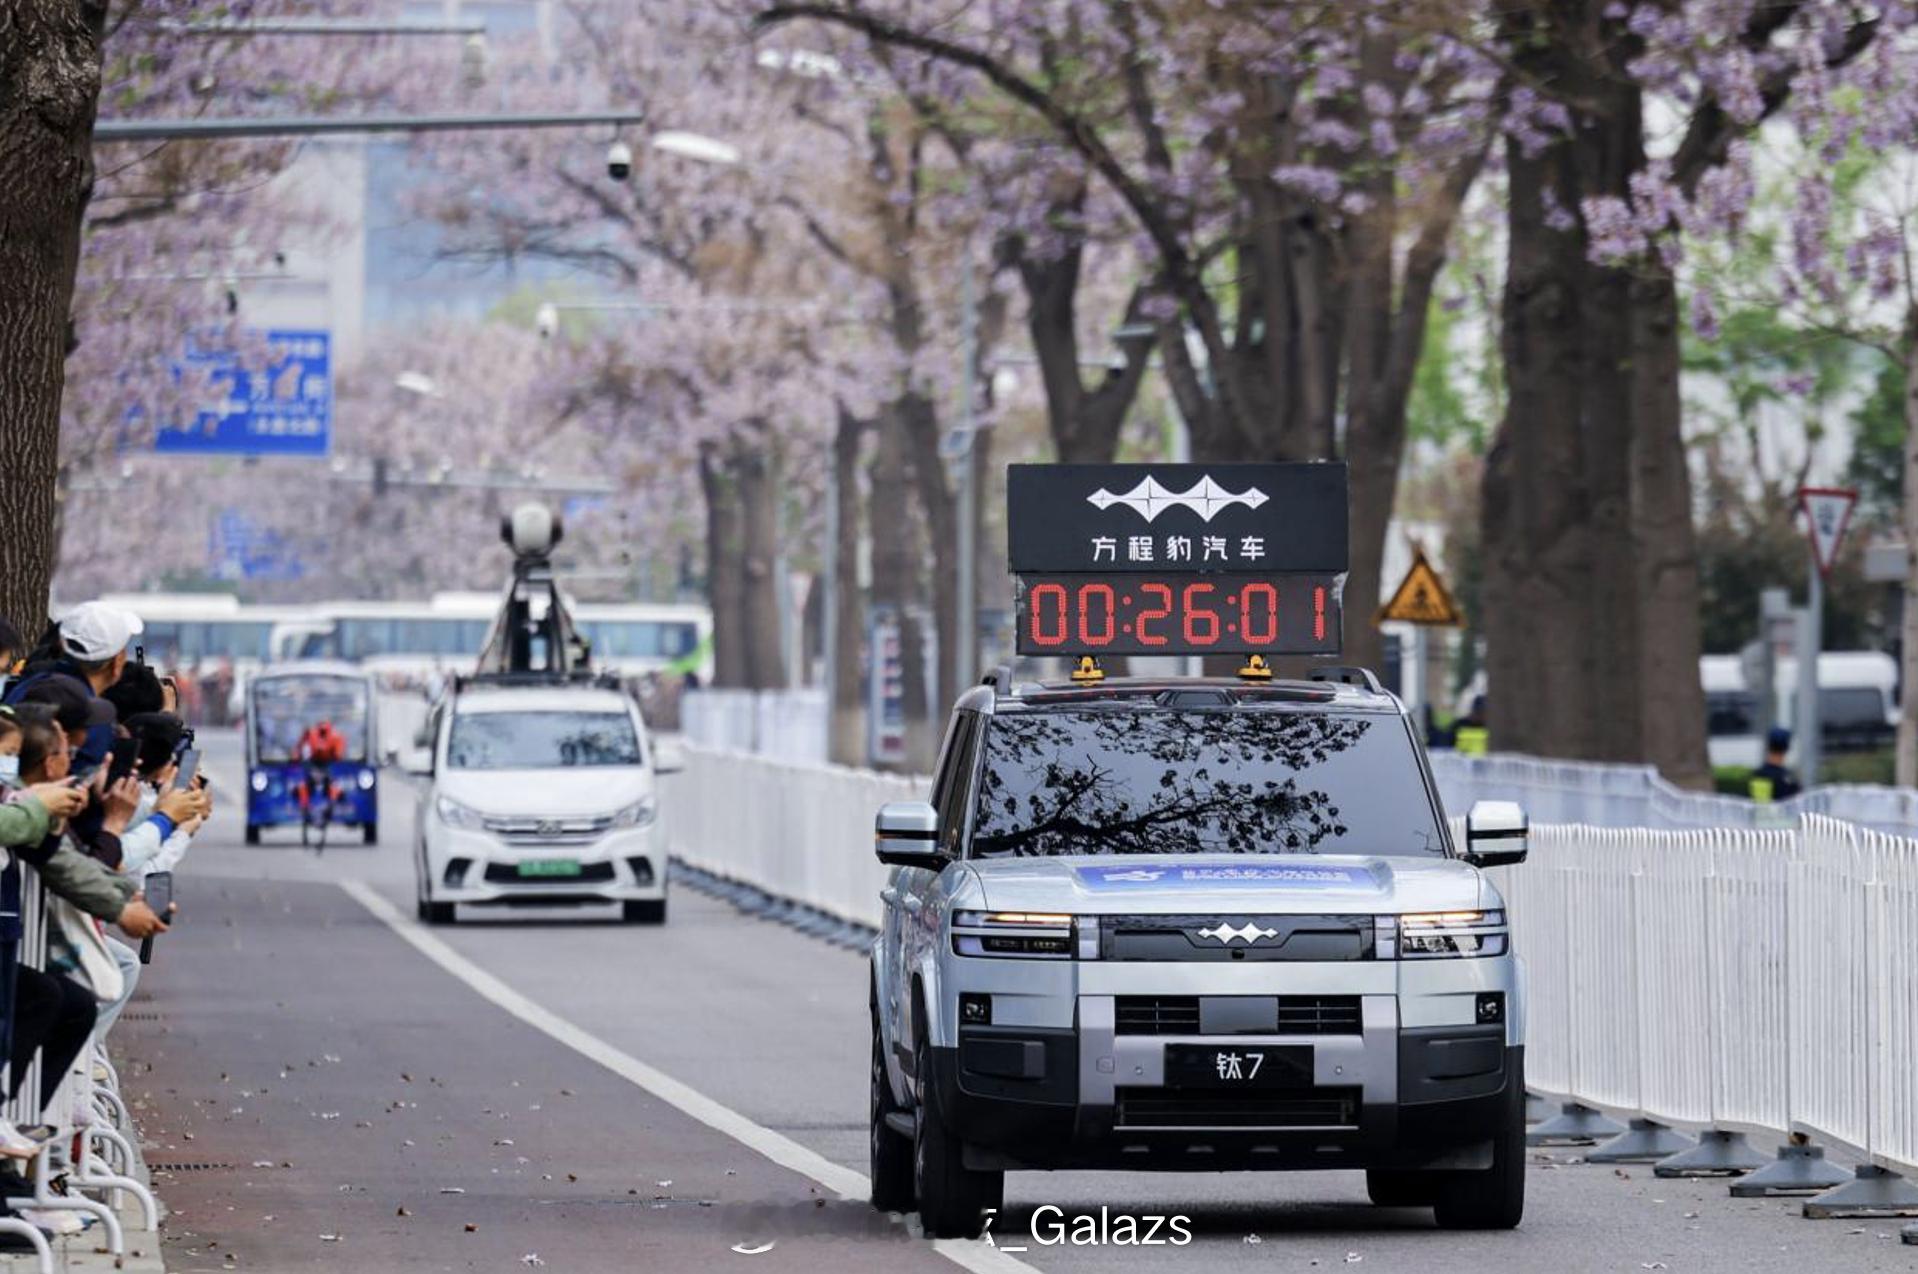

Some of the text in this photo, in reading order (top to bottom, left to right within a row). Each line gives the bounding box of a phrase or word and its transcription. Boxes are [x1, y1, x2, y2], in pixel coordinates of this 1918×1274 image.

[1092, 536, 1265, 562] 方程豹汽车
[1030, 583, 1326, 647] 00:26:01
[1216, 1052, 1264, 1079] 钛7
